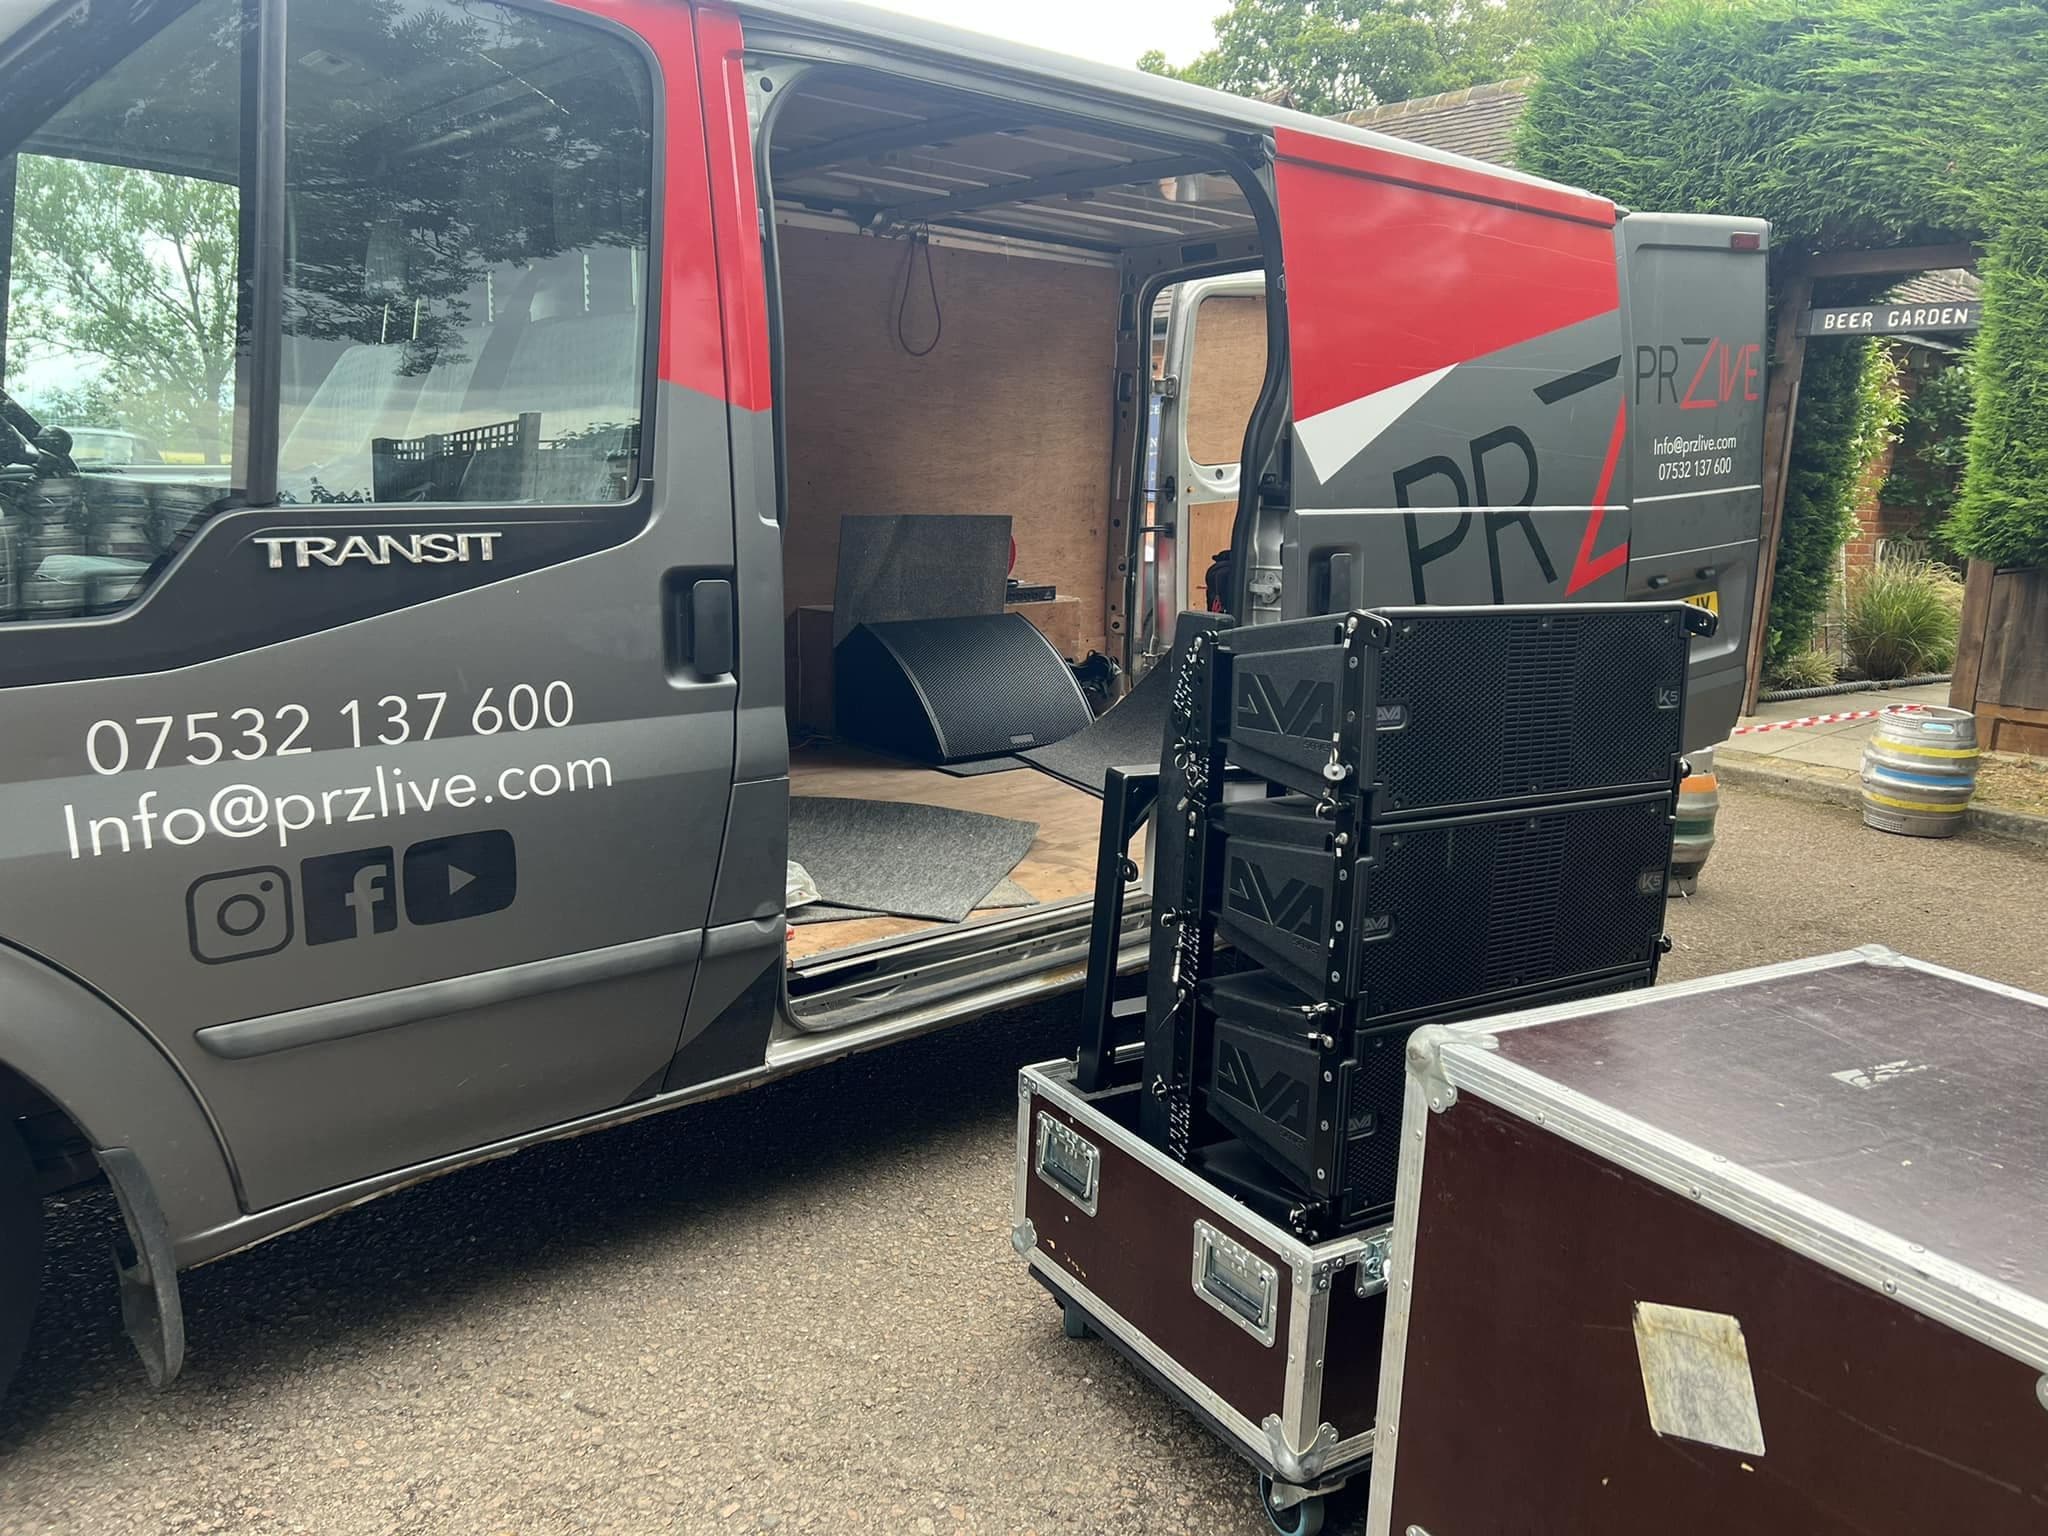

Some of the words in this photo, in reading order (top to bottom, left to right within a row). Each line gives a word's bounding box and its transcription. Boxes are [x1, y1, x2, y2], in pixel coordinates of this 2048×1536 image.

[1824, 312, 1874, 329] BEER
[1888, 308, 1969, 327] GARDEN
[1653, 434, 1737, 457] Info@przlive.com
[1658, 461, 1691, 481] 07532
[1694, 459, 1712, 476] 137
[1714, 457, 1732, 474] 600
[254, 532, 502, 568] TRANSIT
[86, 702, 312, 777] 07532
[339, 692, 449, 750] 137
[471, 679, 575, 736] 600
[64, 754, 614, 860] Info@przlive.com
